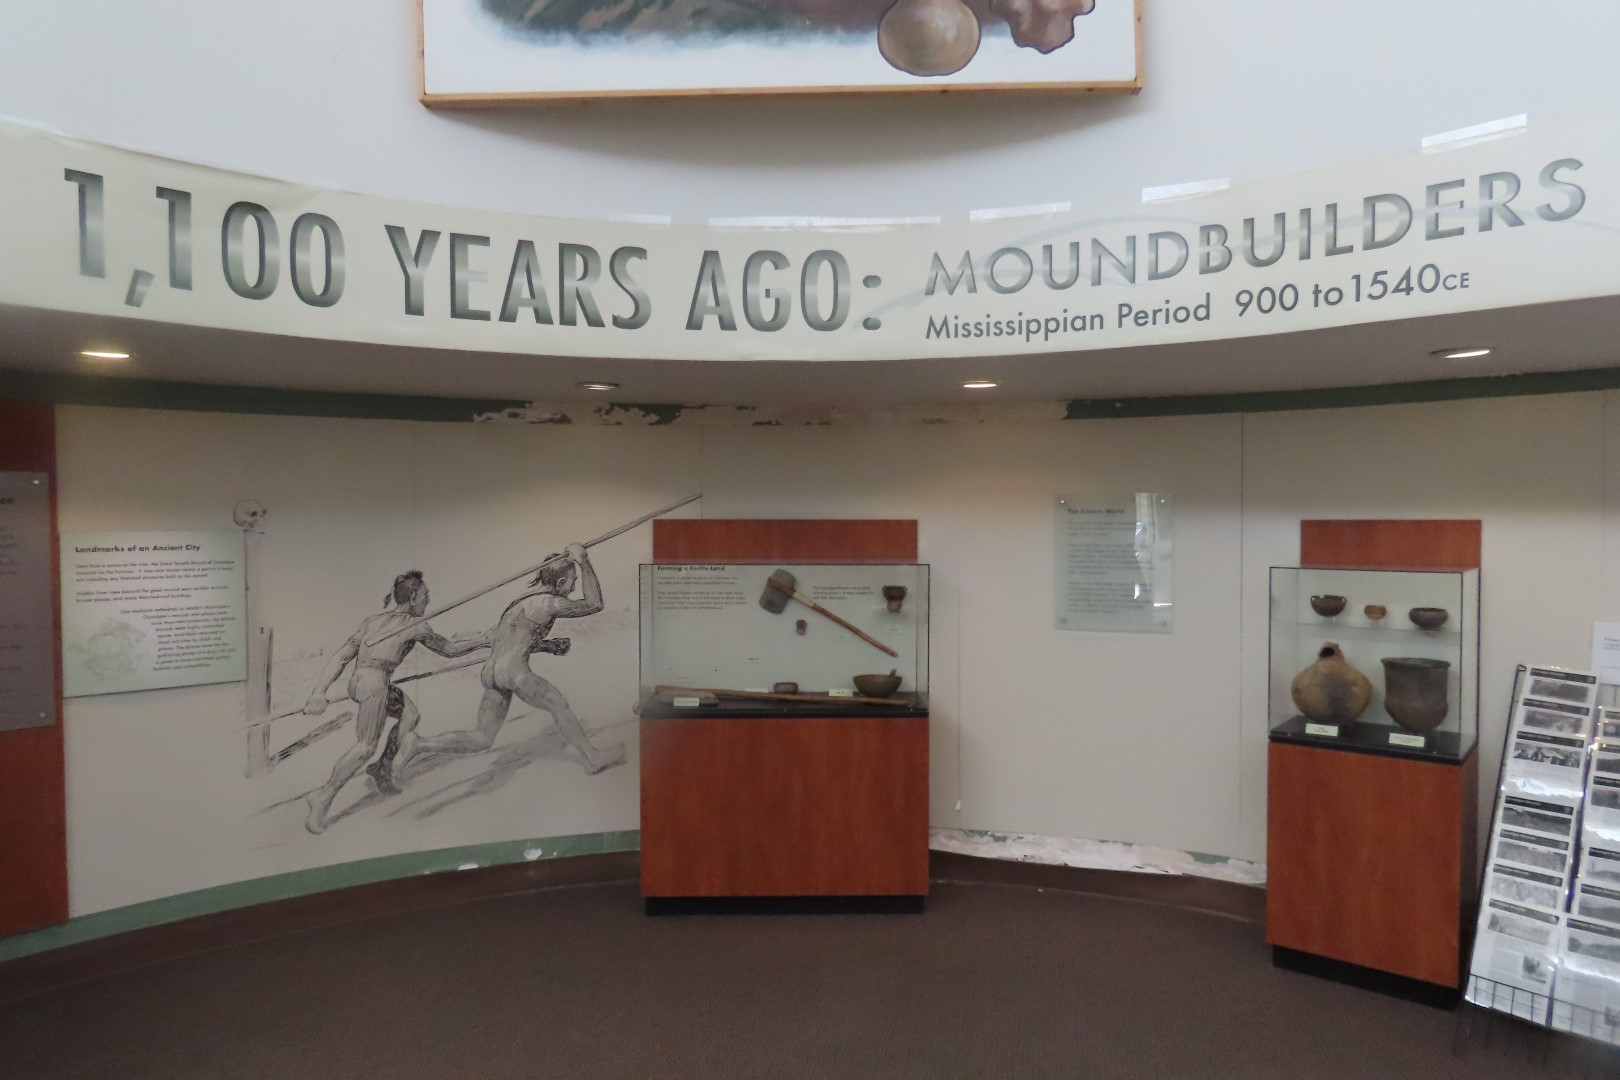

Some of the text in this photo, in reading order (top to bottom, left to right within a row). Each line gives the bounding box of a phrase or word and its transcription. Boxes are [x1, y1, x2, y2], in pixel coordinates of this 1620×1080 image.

[64, 168, 882, 332] 1,100 YEARS AGO:
[924, 157, 1586, 296] MOUNDBUILDERS
[925, 308, 1104, 342] Mississippian
[1118, 292, 1211, 328] Period
[1235, 283, 1299, 317] 900
[1312, 283, 1344, 307] to
[75, 545, 125, 553] Landmarks
[185, 544, 201, 552] City
